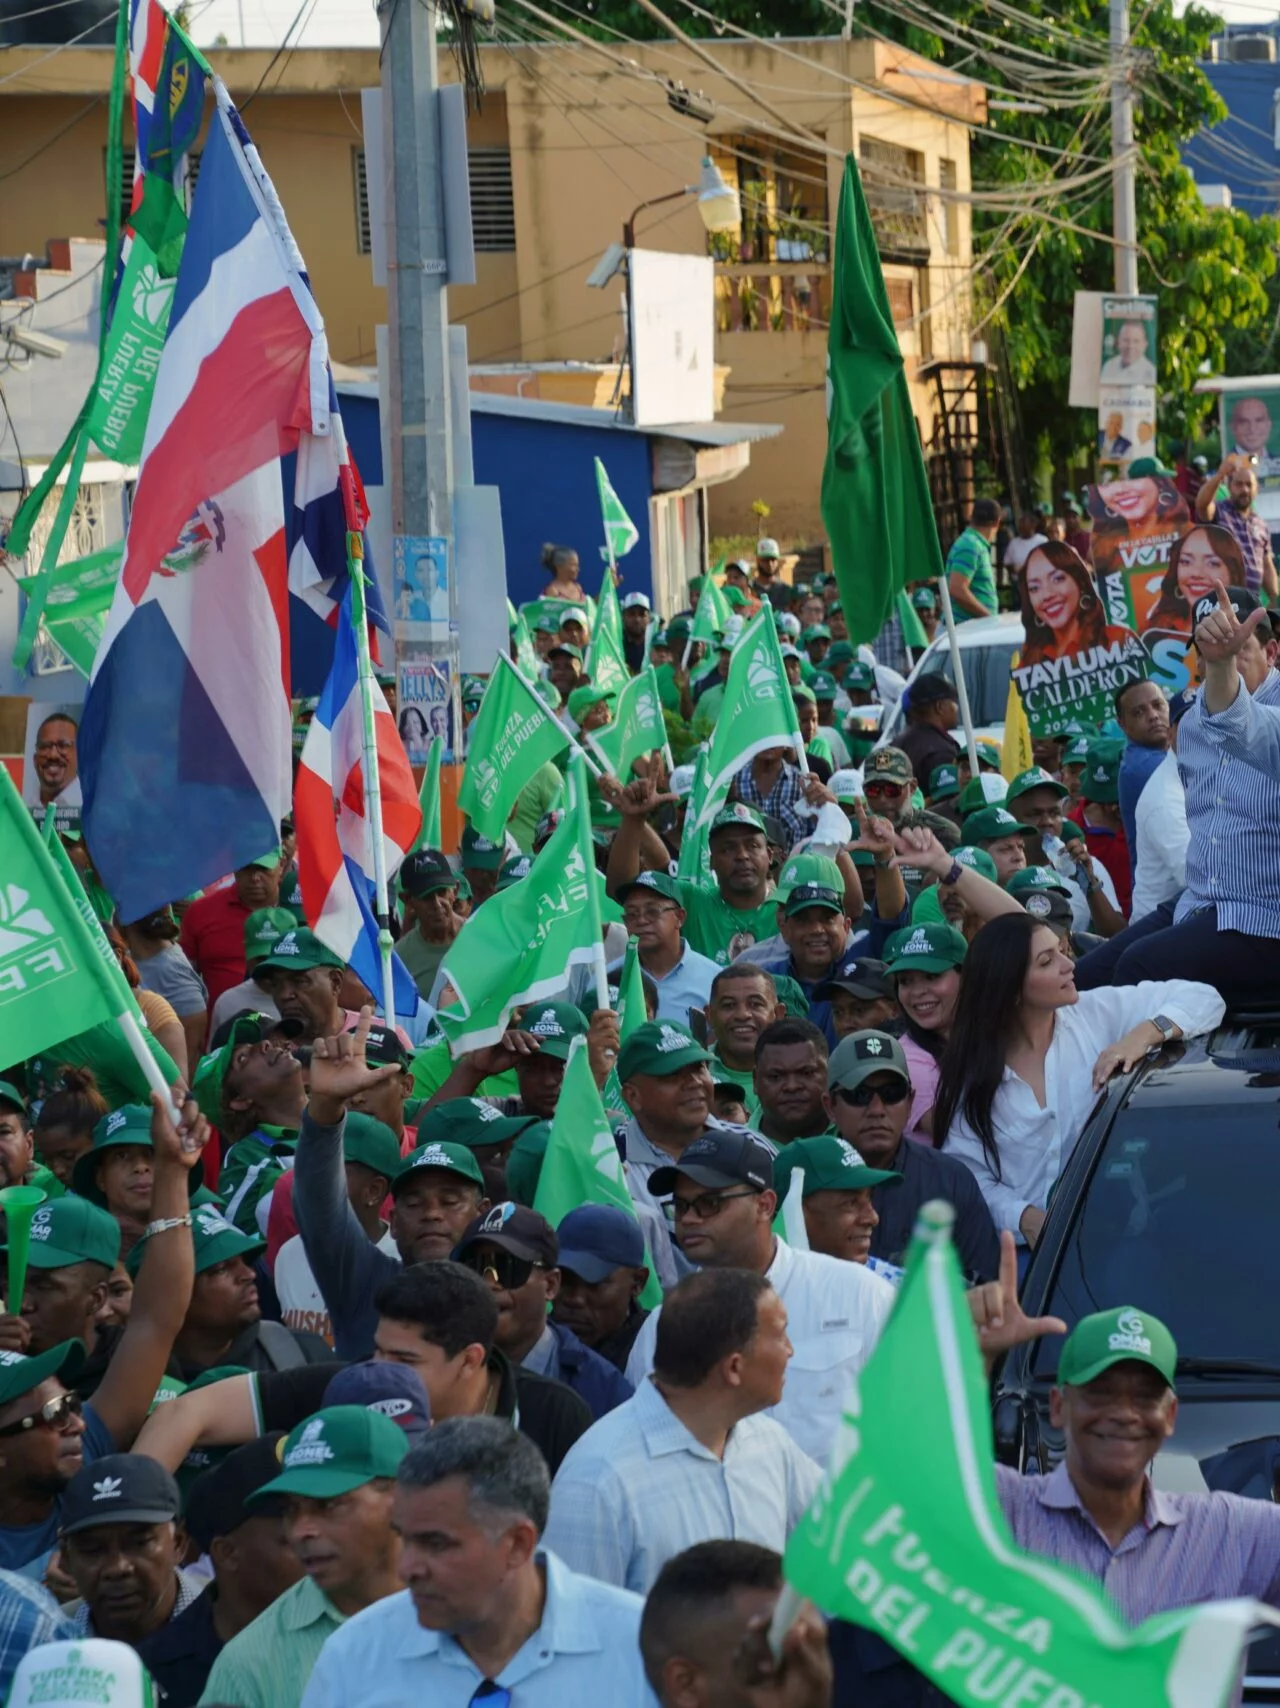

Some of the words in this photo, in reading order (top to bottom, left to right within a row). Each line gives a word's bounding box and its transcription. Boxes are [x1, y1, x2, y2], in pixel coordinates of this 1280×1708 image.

[1119, 542, 1172, 568] VOT
[1012, 640, 1145, 691] TAYLUMA
[1026, 661, 1141, 712] CALDERON
[514, 710, 548, 750] PUEBL
[901, 943, 934, 952] LEONEL
[530, 1024, 565, 1033] LEONEL
[412, 1156, 454, 1166] LEONEL
[31, 1226, 52, 1235] MAR
[1108, 1332, 1151, 1349] OMAR
[845, 1559, 932, 1652] DEL
[931, 1627, 1103, 1708] PUE
